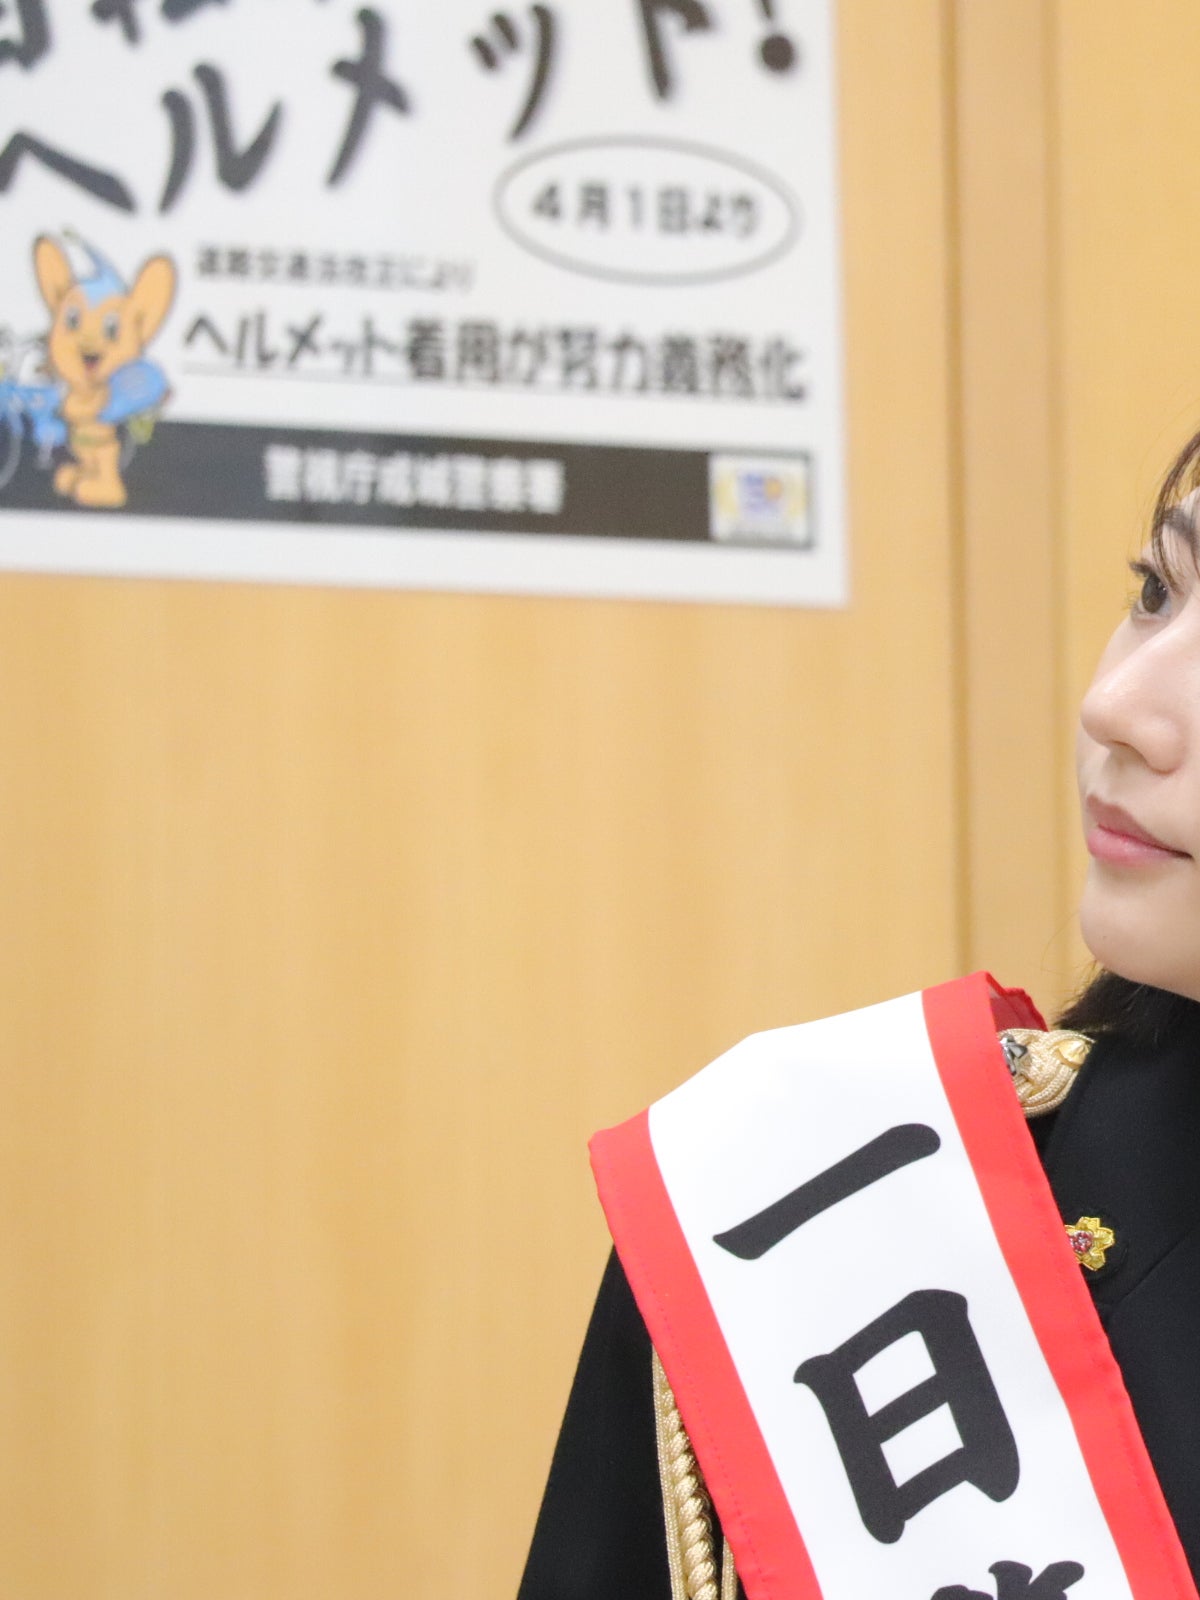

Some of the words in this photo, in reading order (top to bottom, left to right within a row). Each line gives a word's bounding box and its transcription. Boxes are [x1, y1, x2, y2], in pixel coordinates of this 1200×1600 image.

[533, 178, 758, 240] 4月1日より
[185, 311, 806, 402] ヘルメット着用が努力義務化
[712, 1123, 1085, 1600] 一日
